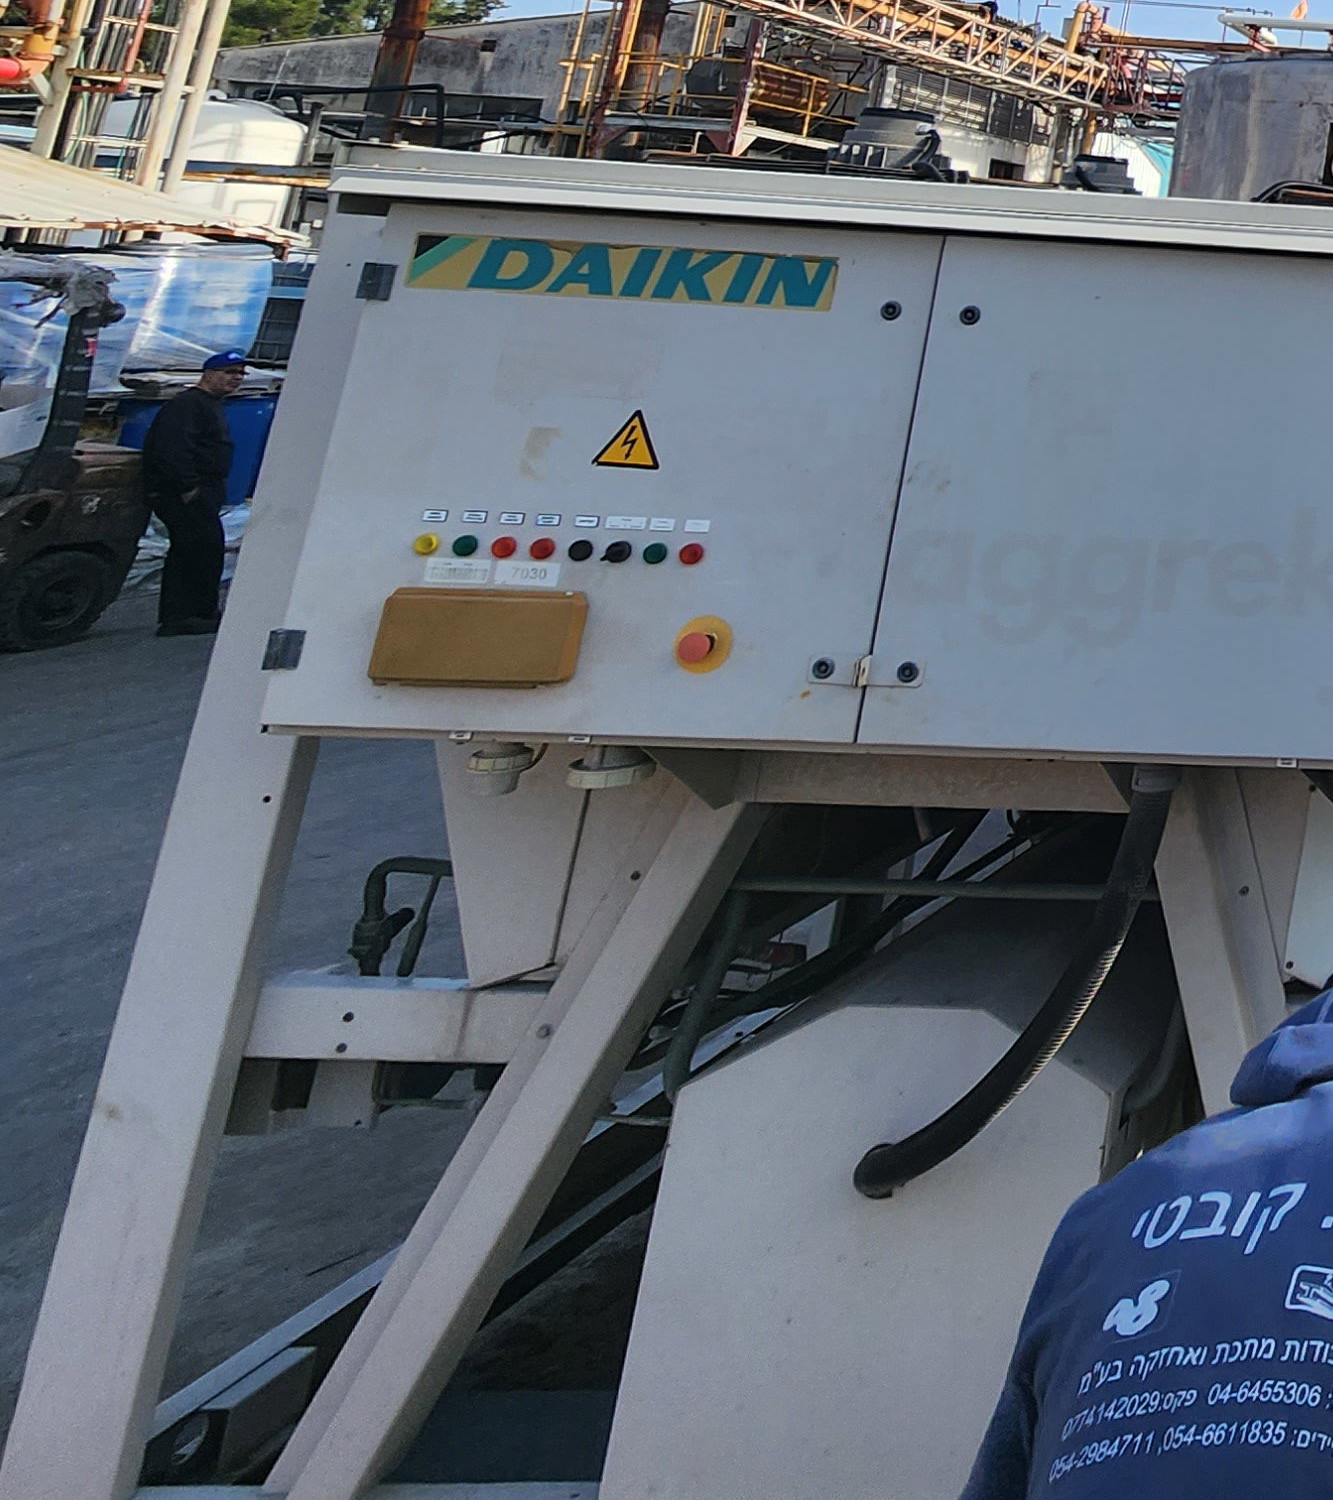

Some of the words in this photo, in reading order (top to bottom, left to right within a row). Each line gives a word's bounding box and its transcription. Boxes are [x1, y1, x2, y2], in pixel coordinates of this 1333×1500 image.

[467, 239, 838, 307] DAIKIN
[511, 566, 548, 580] 7030
[1131, 1182, 1307, 1255] קובטי
[1128, 1345, 1208, 1382] ואחזקה
[1211, 1337, 1275, 1365] מתכת
[1207, 1380, 1322, 1408] 04-6455306
